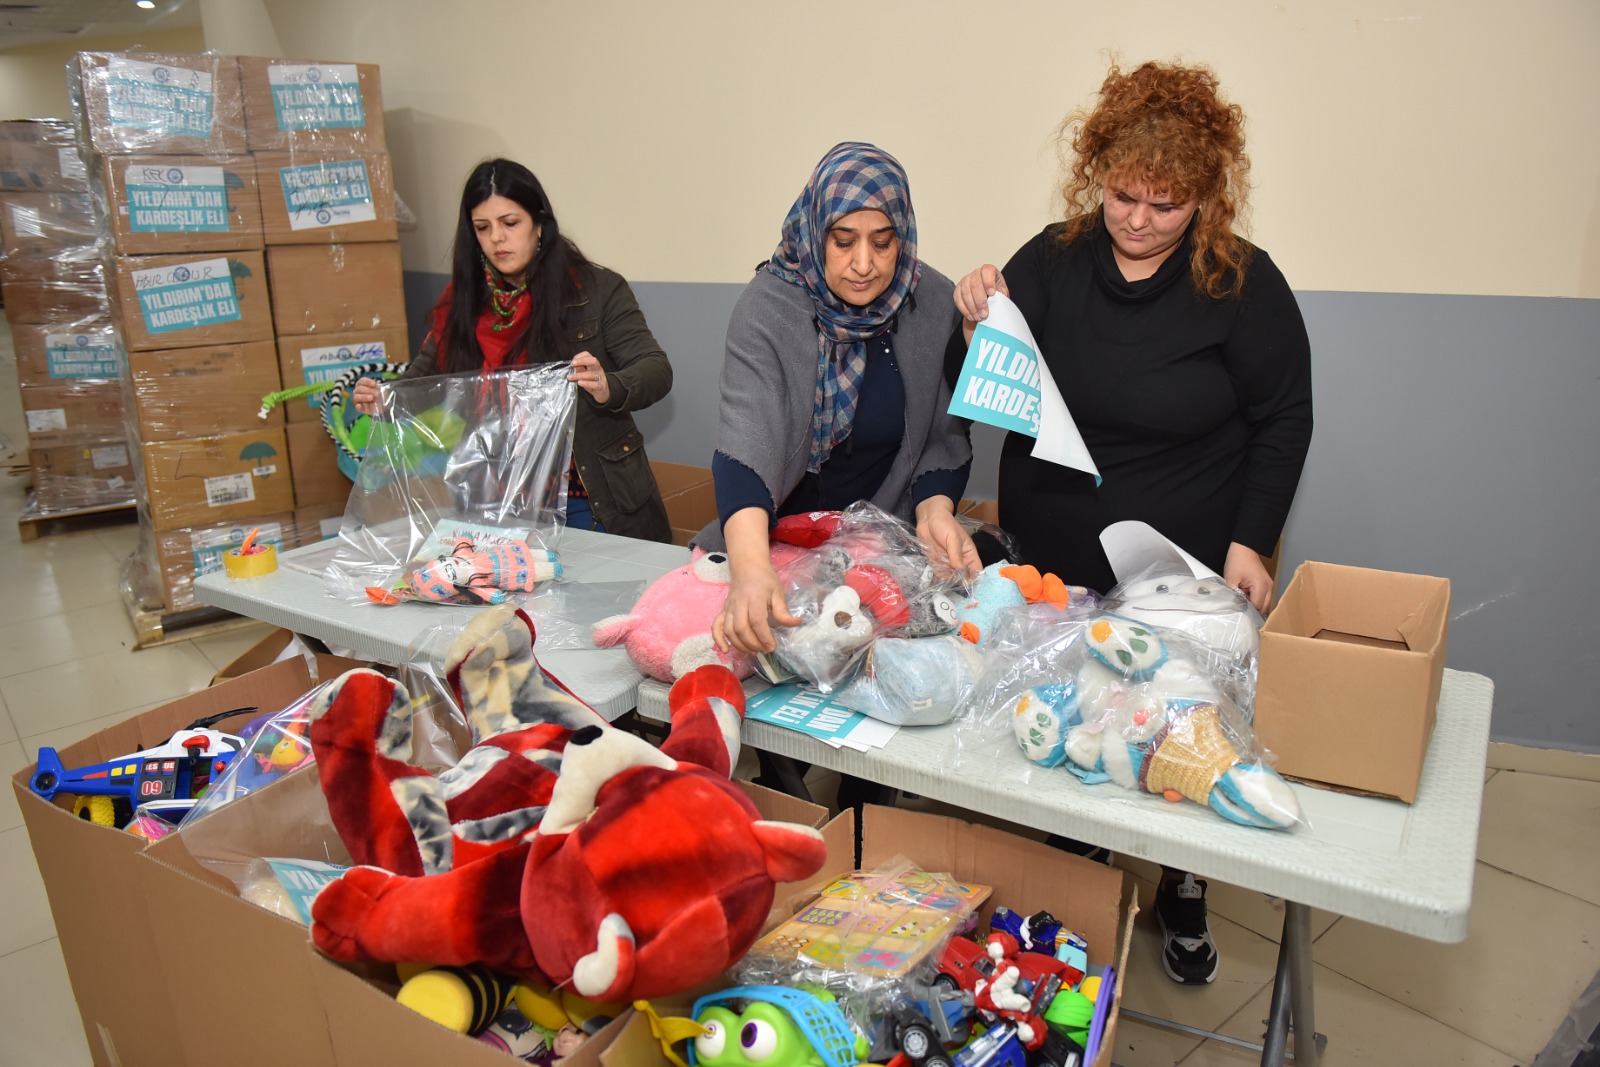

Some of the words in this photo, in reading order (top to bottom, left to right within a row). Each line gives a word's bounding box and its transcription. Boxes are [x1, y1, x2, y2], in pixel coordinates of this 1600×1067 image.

[132, 190, 223, 208] YILDIRIM'DAN
[136, 209, 204, 230] KARDEŞLİK
[143, 281, 232, 311] YILDIRIM'DAN
[150, 302, 217, 328] KARDEŞLİK
[217, 298, 237, 317] ELİ
[142, 780, 162, 796] 09
